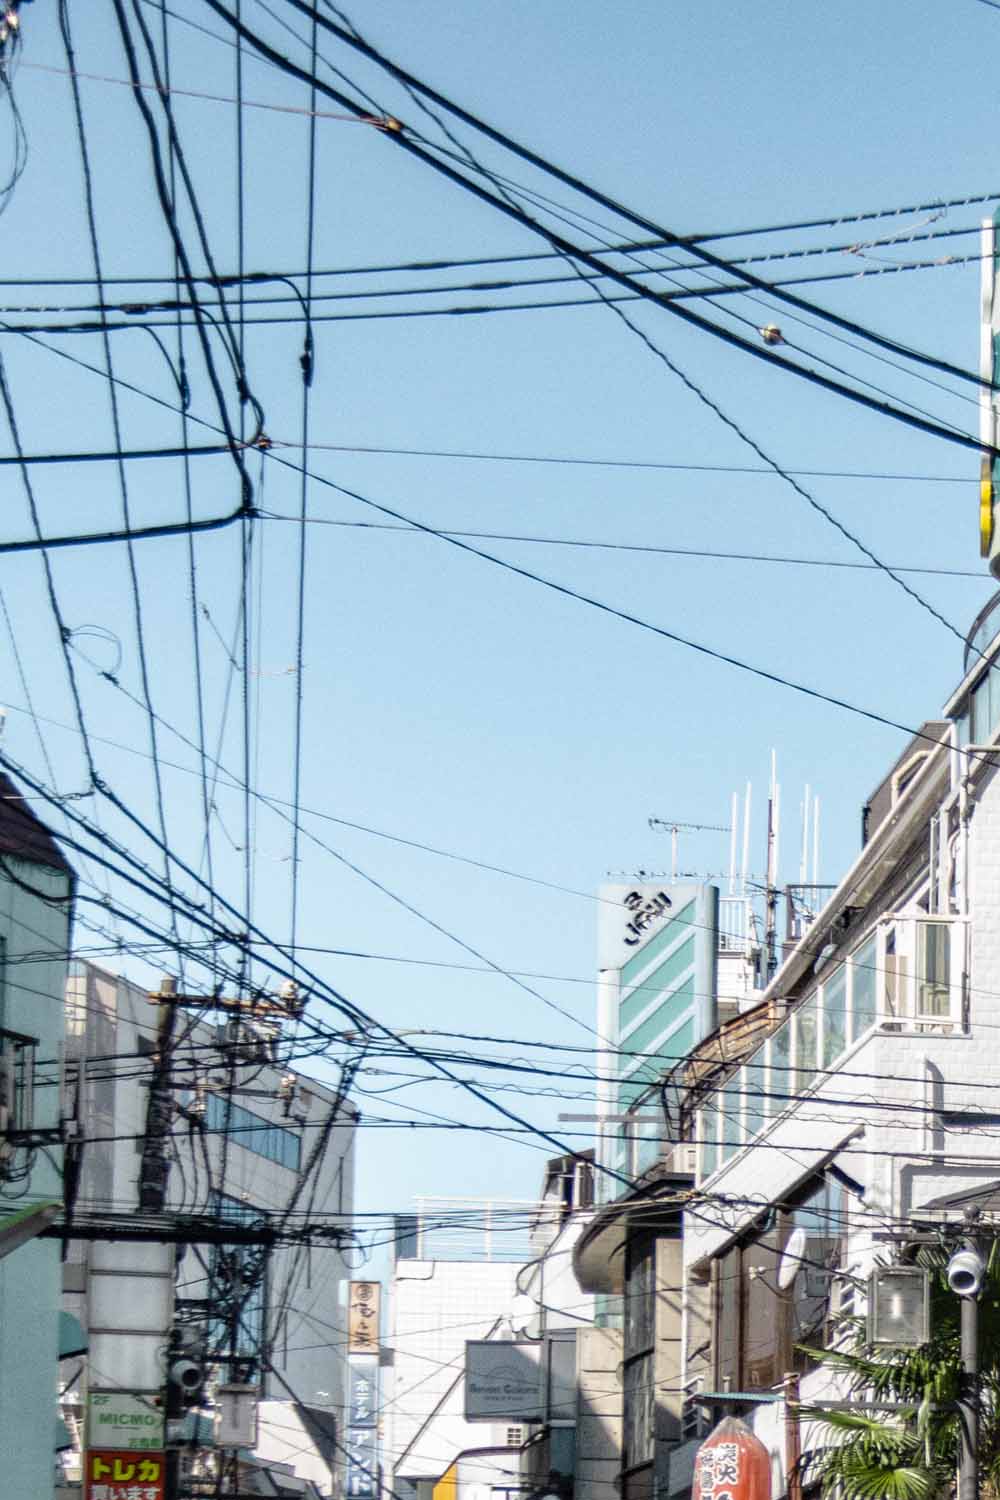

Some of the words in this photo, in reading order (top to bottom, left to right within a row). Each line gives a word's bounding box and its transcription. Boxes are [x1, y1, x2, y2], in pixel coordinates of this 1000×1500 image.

[92, 1457, 161, 1482] トレカ
[717, 1444, 737, 1482] 炭火
